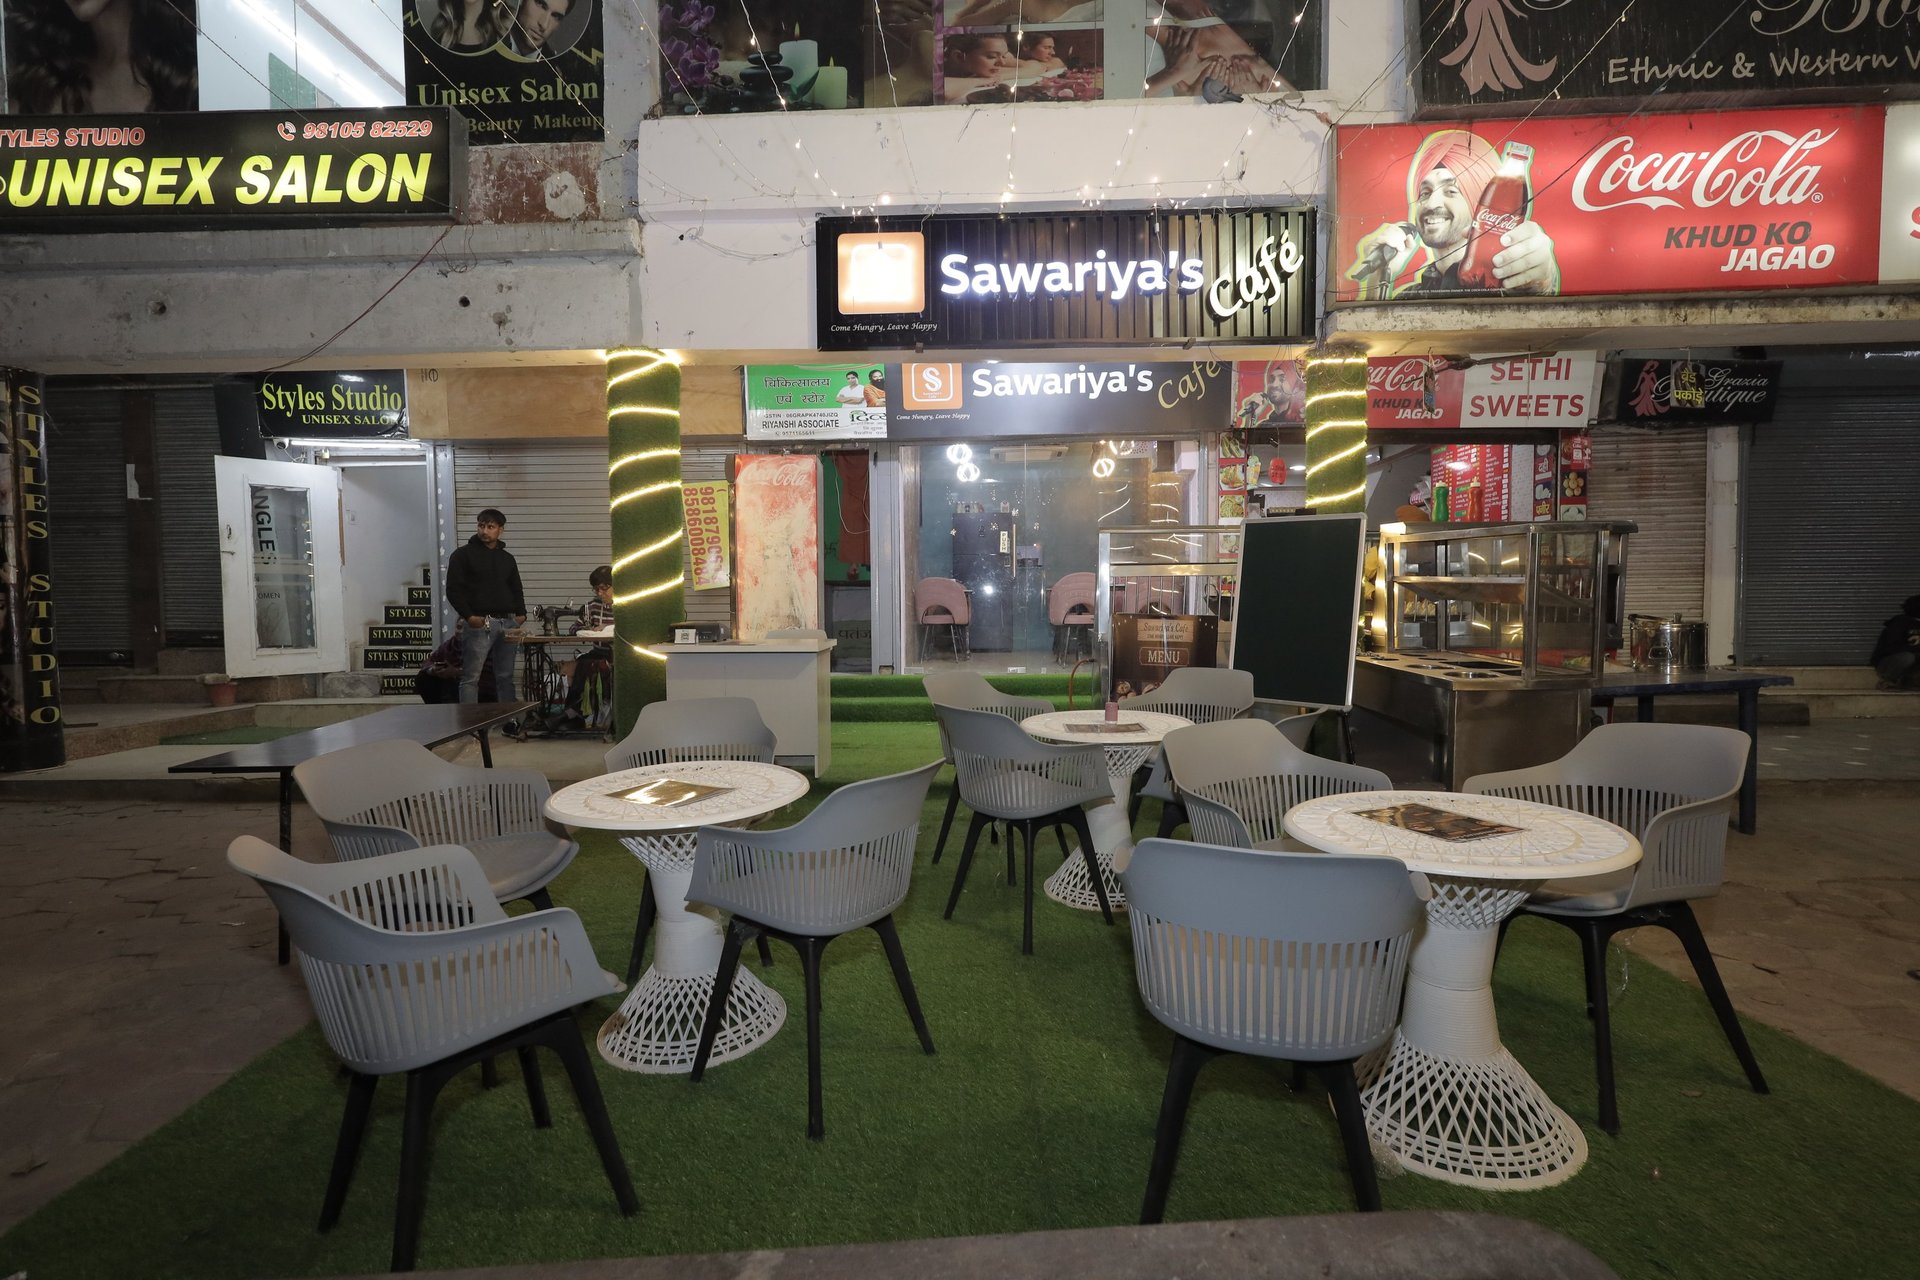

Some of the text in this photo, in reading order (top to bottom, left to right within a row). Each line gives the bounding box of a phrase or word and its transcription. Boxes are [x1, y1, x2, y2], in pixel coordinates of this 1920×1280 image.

[1608, 56, 1723, 84] Ethnic
[1732, 52, 1755, 79] &
[1769, 47, 1898, 77] Western
[417, 77, 599, 106] Unisex Salon
[302, 120, 433, 139] 98105 82529
[468, 113, 604, 136] Beauty Makeup
[65, 127, 145, 147] STUDIO
[8, 153, 432, 208] UNISEX SALON
[1572, 128, 1839, 211] Coca-Cola
[1663, 221, 1812, 250] KHUD KO
[1720, 244, 1836, 272] JAGAO
[940, 230, 1304, 318] Sawariya's Café
[831, 324, 851, 332] Come
[887, 322, 909, 331] Leave
[911, 322, 938, 332] Happy
[1490, 357, 1572, 381] SETHI
[1707, 367, 1769, 389] Grazia
[764, 377, 830, 389] चिकित्सालय
[972, 364, 1153, 399] Sawariya's
[263, 383, 402, 417] Styles Studio
[776, 391, 826, 405] एवं स्टोर
[1372, 398, 1413, 409] KHUD
[1469, 394, 1584, 418] SWEETS
[302, 414, 398, 425] UNISEX SALON
[762, 419, 839, 429] RIYANSHI ASSOCIATE
[935, 412, 950, 420] Leave
[952, 412, 970, 421] Happy
[16, 385, 62, 724] STYLES STUDIO
[389, 608, 426, 617] STYLES
[372, 629, 403, 639] STYLES
[367, 652, 399, 661] STYLES
[1148, 650, 1180, 664] MENU
